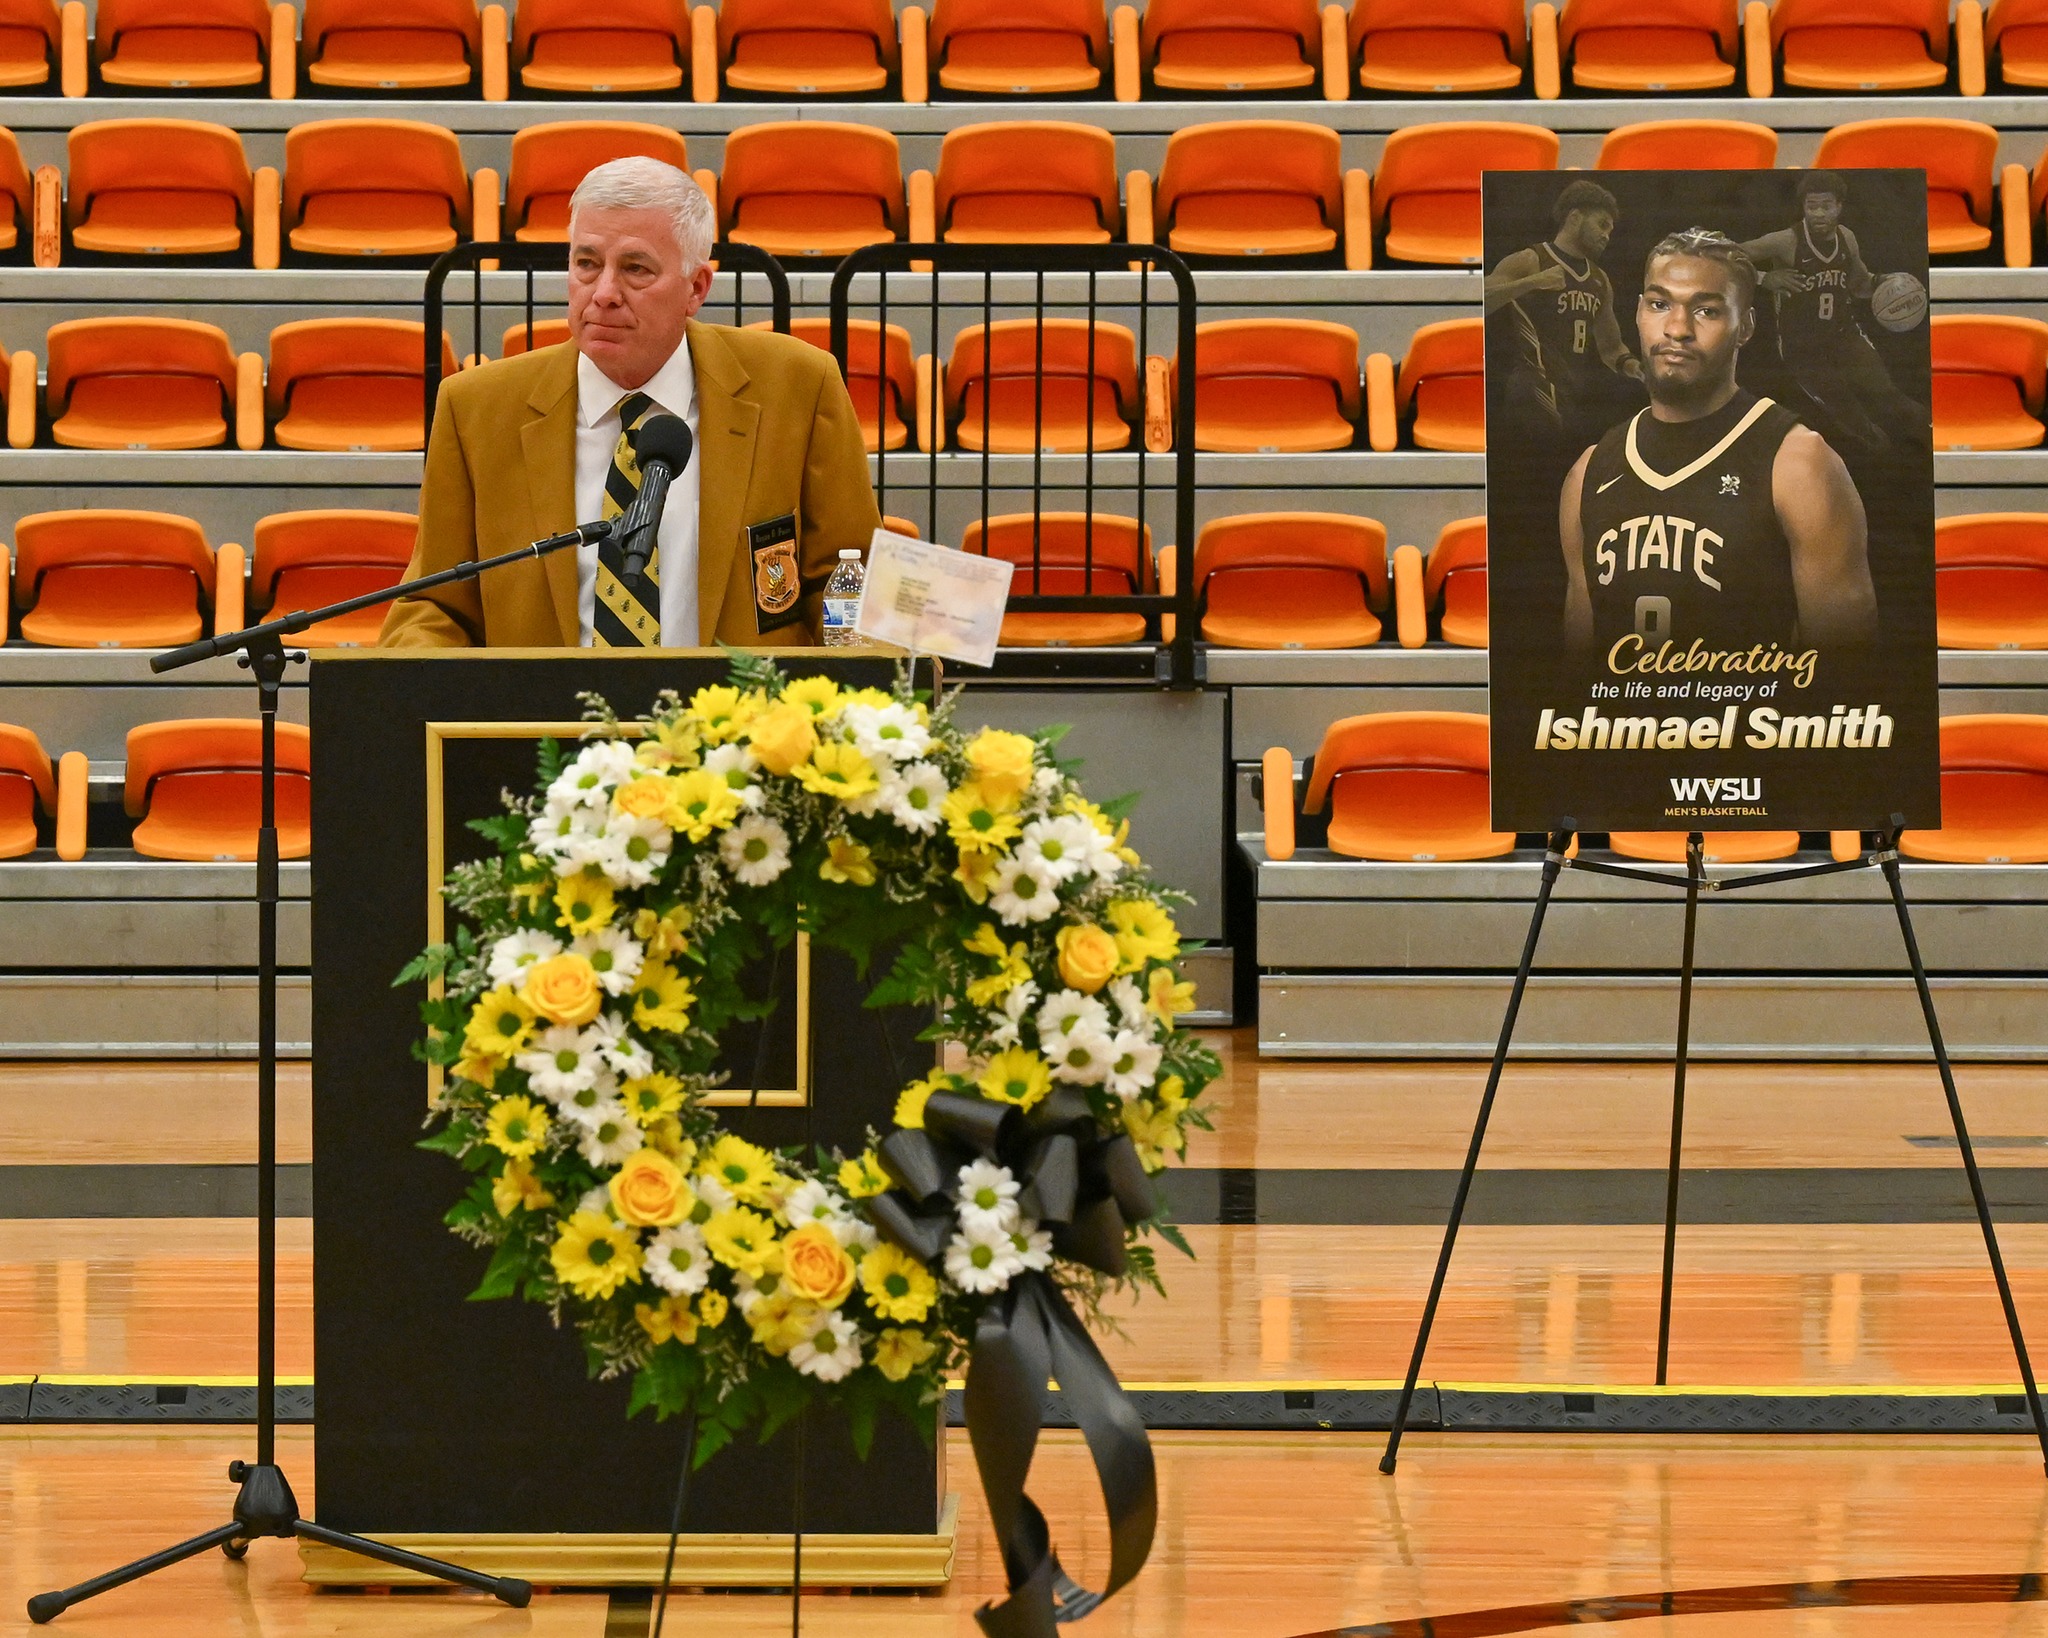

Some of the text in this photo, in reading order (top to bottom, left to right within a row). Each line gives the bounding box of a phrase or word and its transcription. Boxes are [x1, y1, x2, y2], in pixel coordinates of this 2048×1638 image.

[1805, 270, 1847, 291] STATE
[1818, 292, 1834, 320] 8
[1573, 319, 1587, 354] 8
[1596, 515, 1724, 592] STATE
[1607, 633, 1818, 688] Celebrating
[1591, 680, 1778, 701] the life and legacy of
[1534, 704, 1895, 750] Ishmael Smith
[1669, 777, 1761, 804] WVSU
[1664, 806, 1768, 816] MEN'S BASKETBALL
